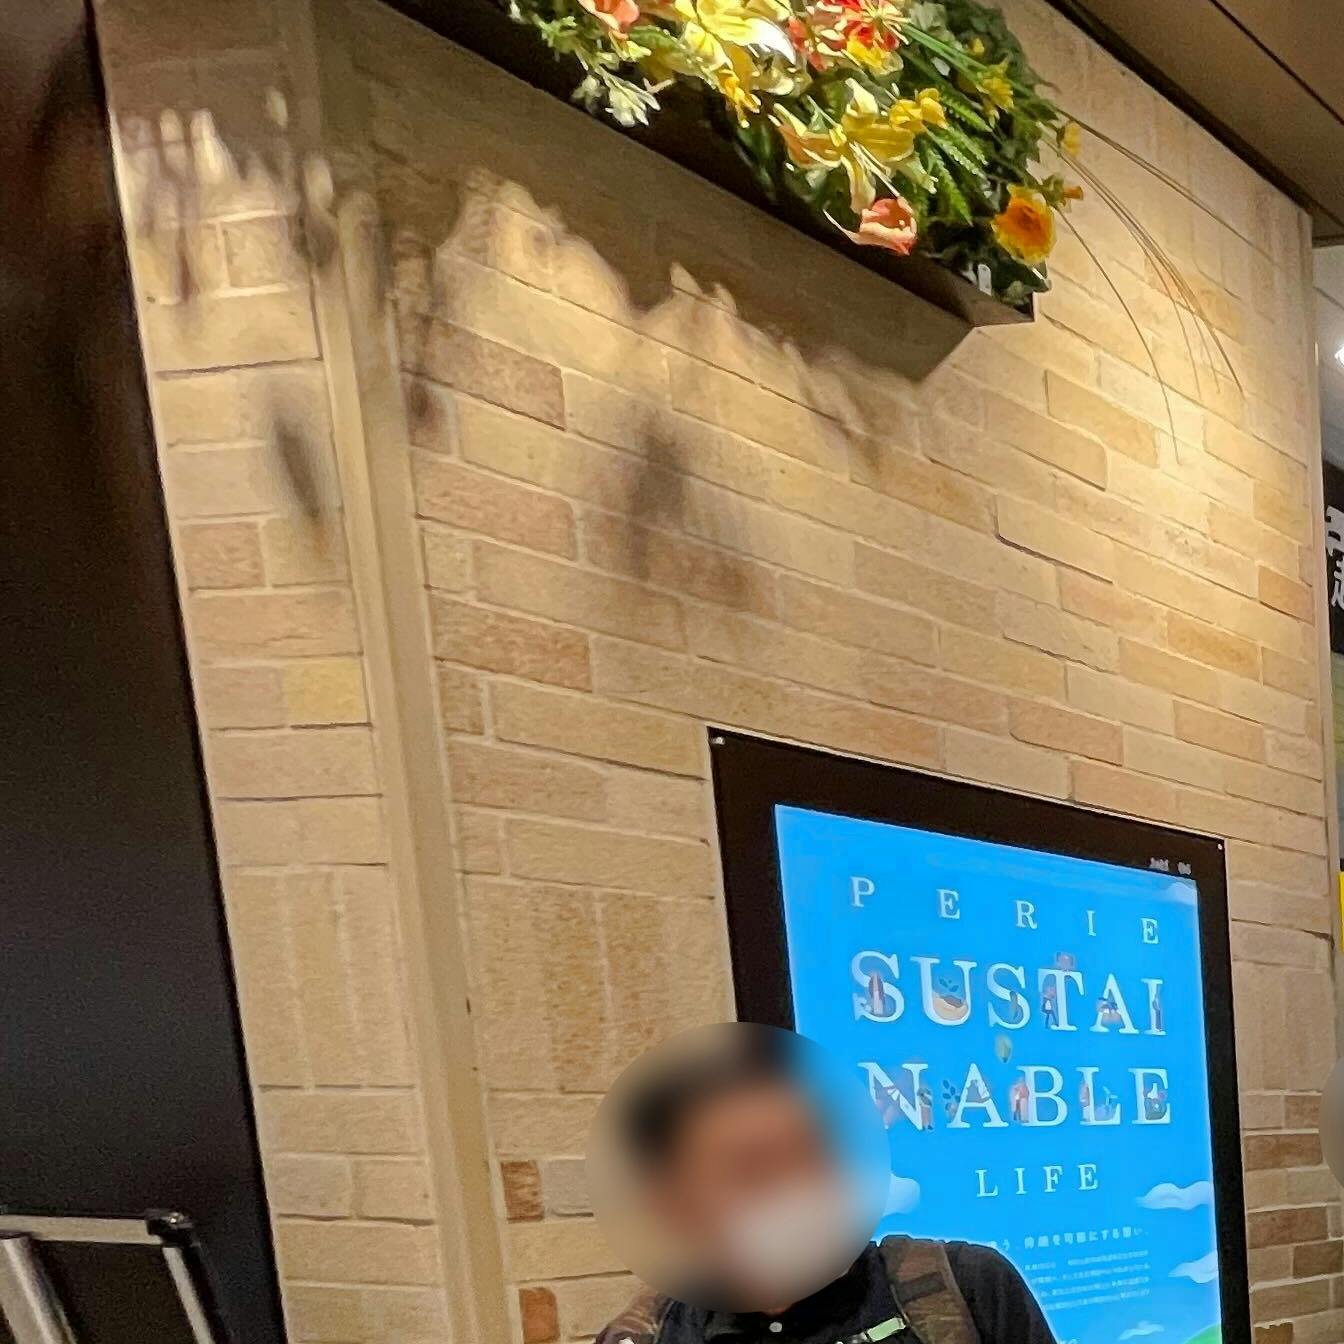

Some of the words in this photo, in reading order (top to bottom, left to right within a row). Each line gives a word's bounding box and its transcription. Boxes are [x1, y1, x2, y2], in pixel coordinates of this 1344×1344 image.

[849, 876, 1160, 945] PERIE
[851, 950, 1167, 1036] SUSTAI
[858, 1062, 1173, 1132] NABLE
[976, 1163, 1099, 1198] LIFE
